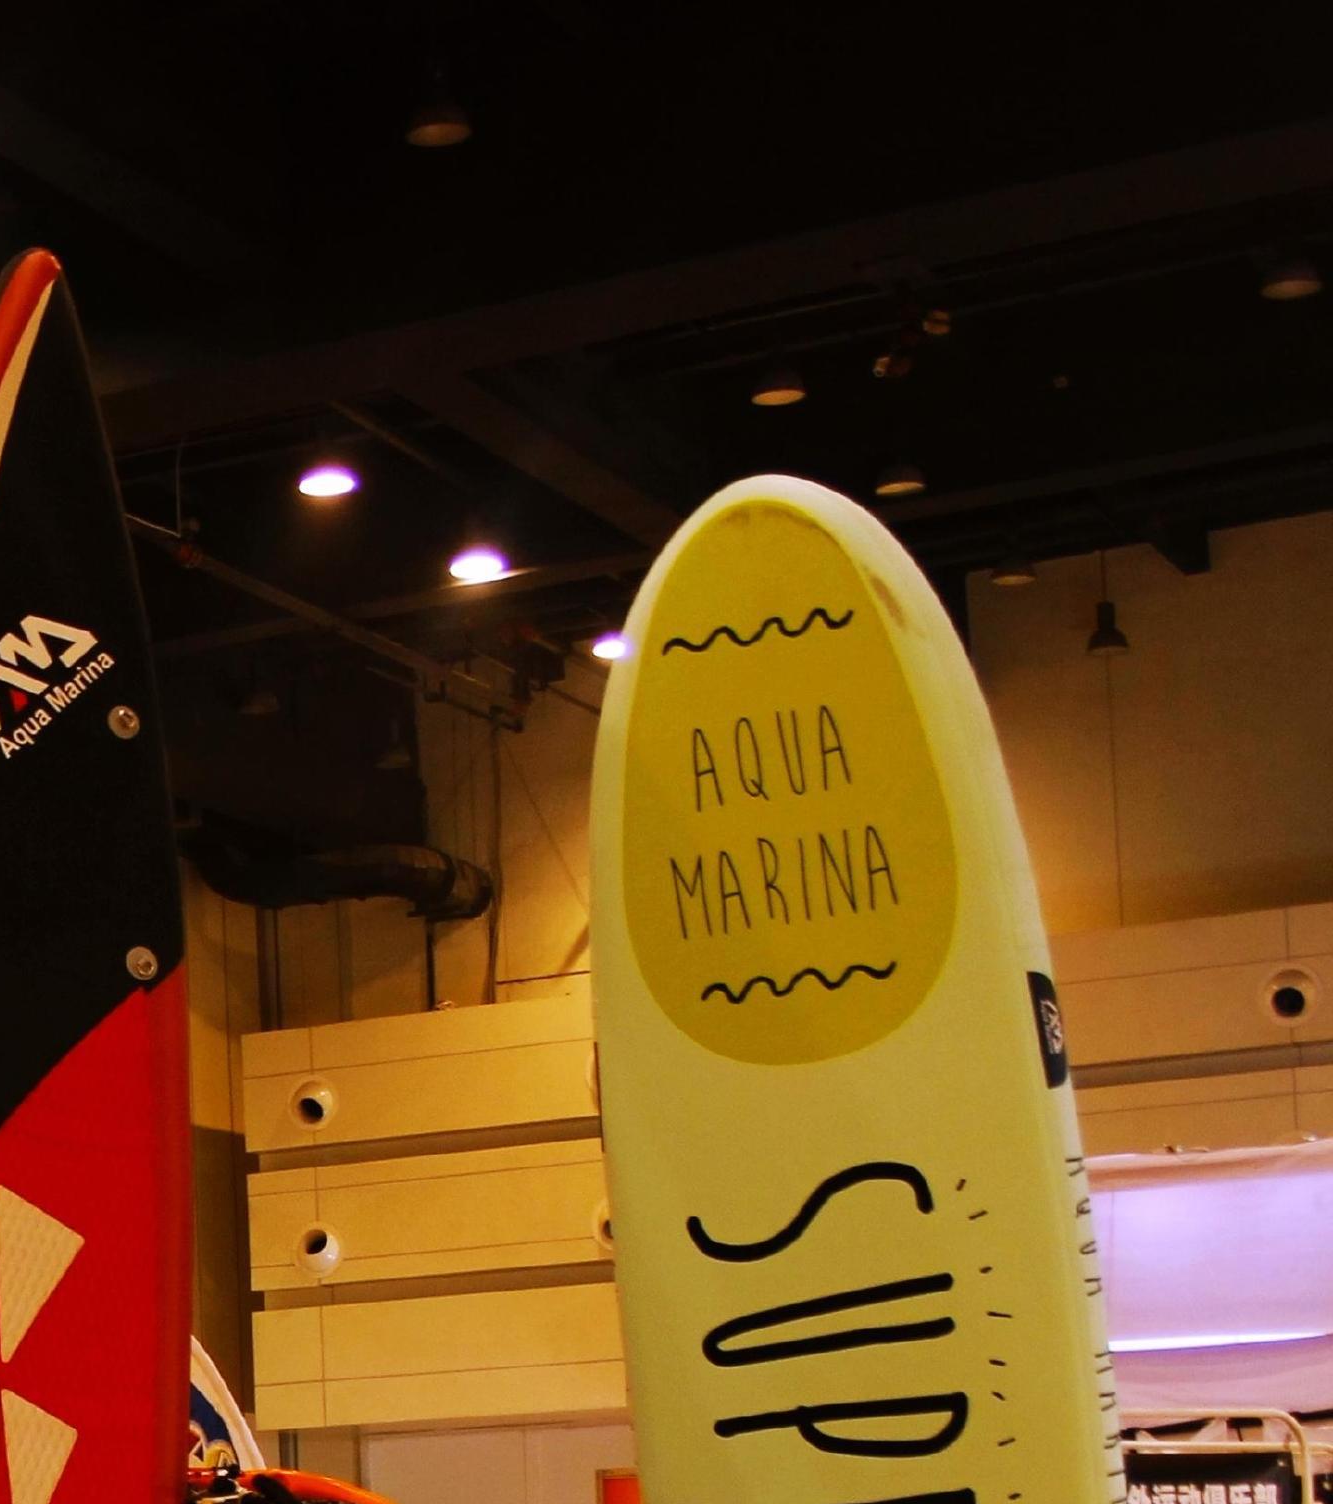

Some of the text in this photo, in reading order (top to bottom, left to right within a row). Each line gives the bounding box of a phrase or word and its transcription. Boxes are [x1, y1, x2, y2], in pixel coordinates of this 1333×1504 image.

[44, 652, 115, 713] Marina
[689, 705, 852, 812] AQUA
[670, 825, 899, 940] MARINA
